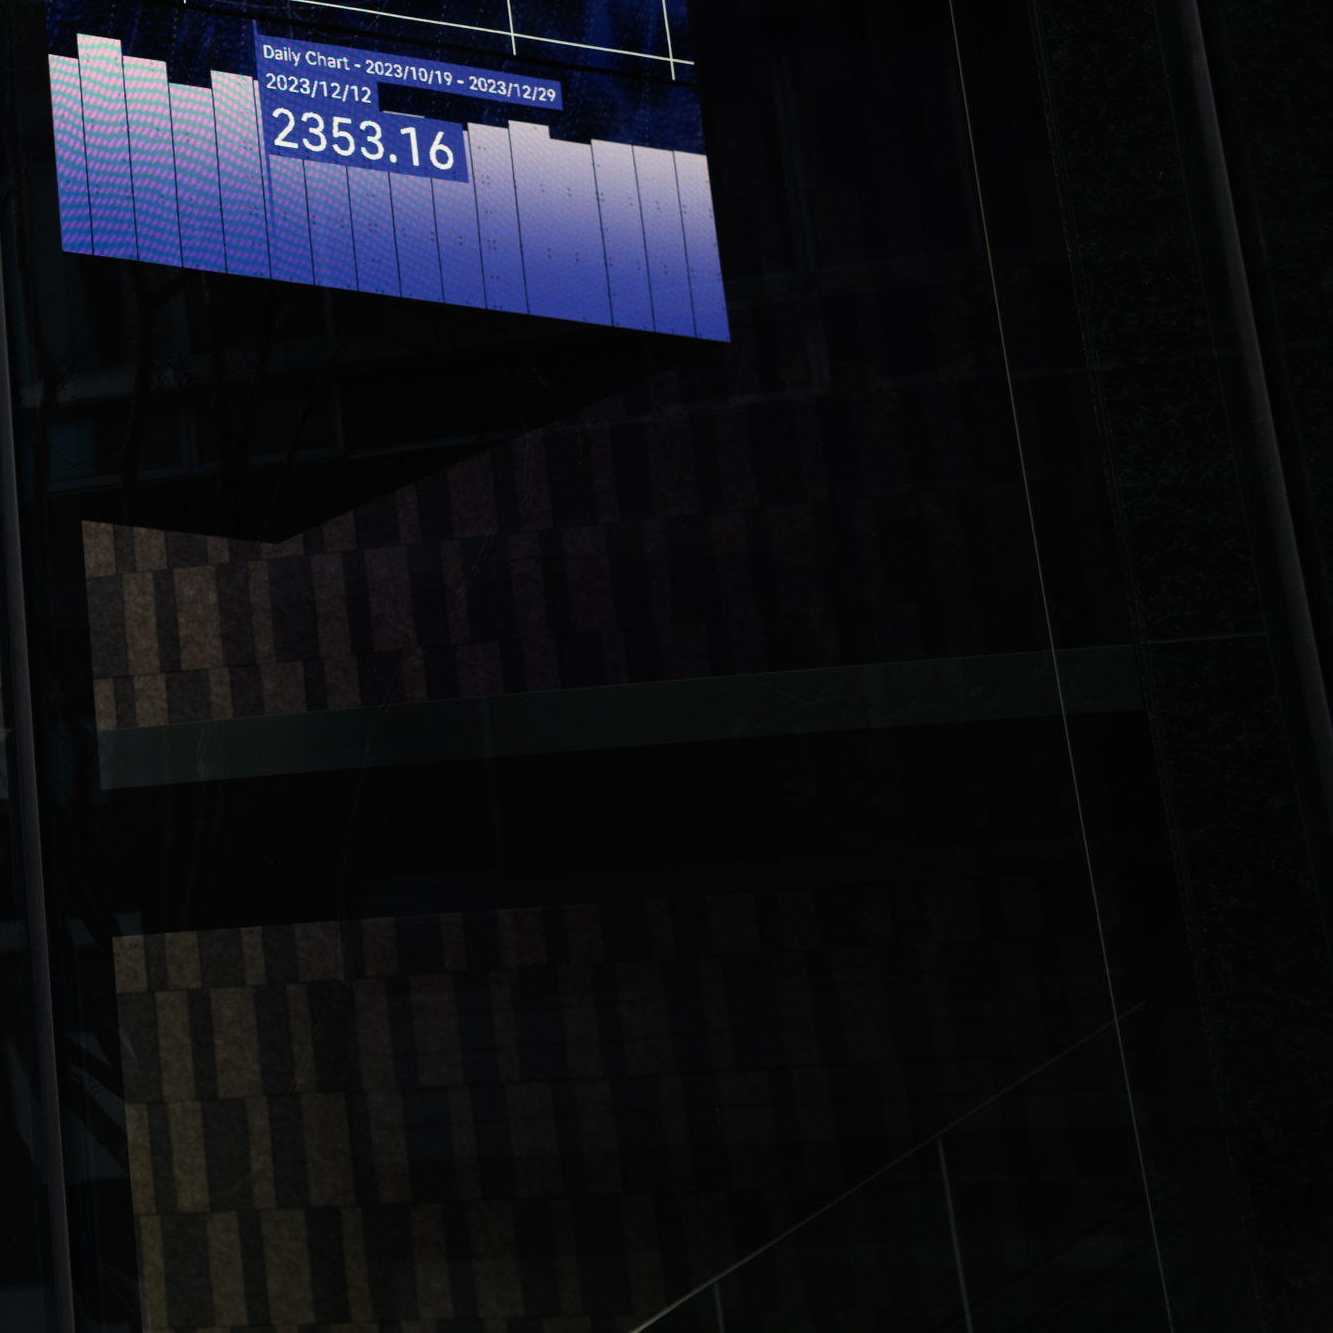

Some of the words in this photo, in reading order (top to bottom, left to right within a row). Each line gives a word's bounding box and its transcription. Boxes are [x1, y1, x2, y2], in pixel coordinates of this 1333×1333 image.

[263, 44, 301, 67] Daily
[305, 51, 349, 71] Chart
[366, 60, 453, 86] 2023/10/19
[468, 76, 557, 103] 2023/12/29
[265, 72, 372, 104] 2023/12/12
[271, 107, 455, 171] 2353.16
